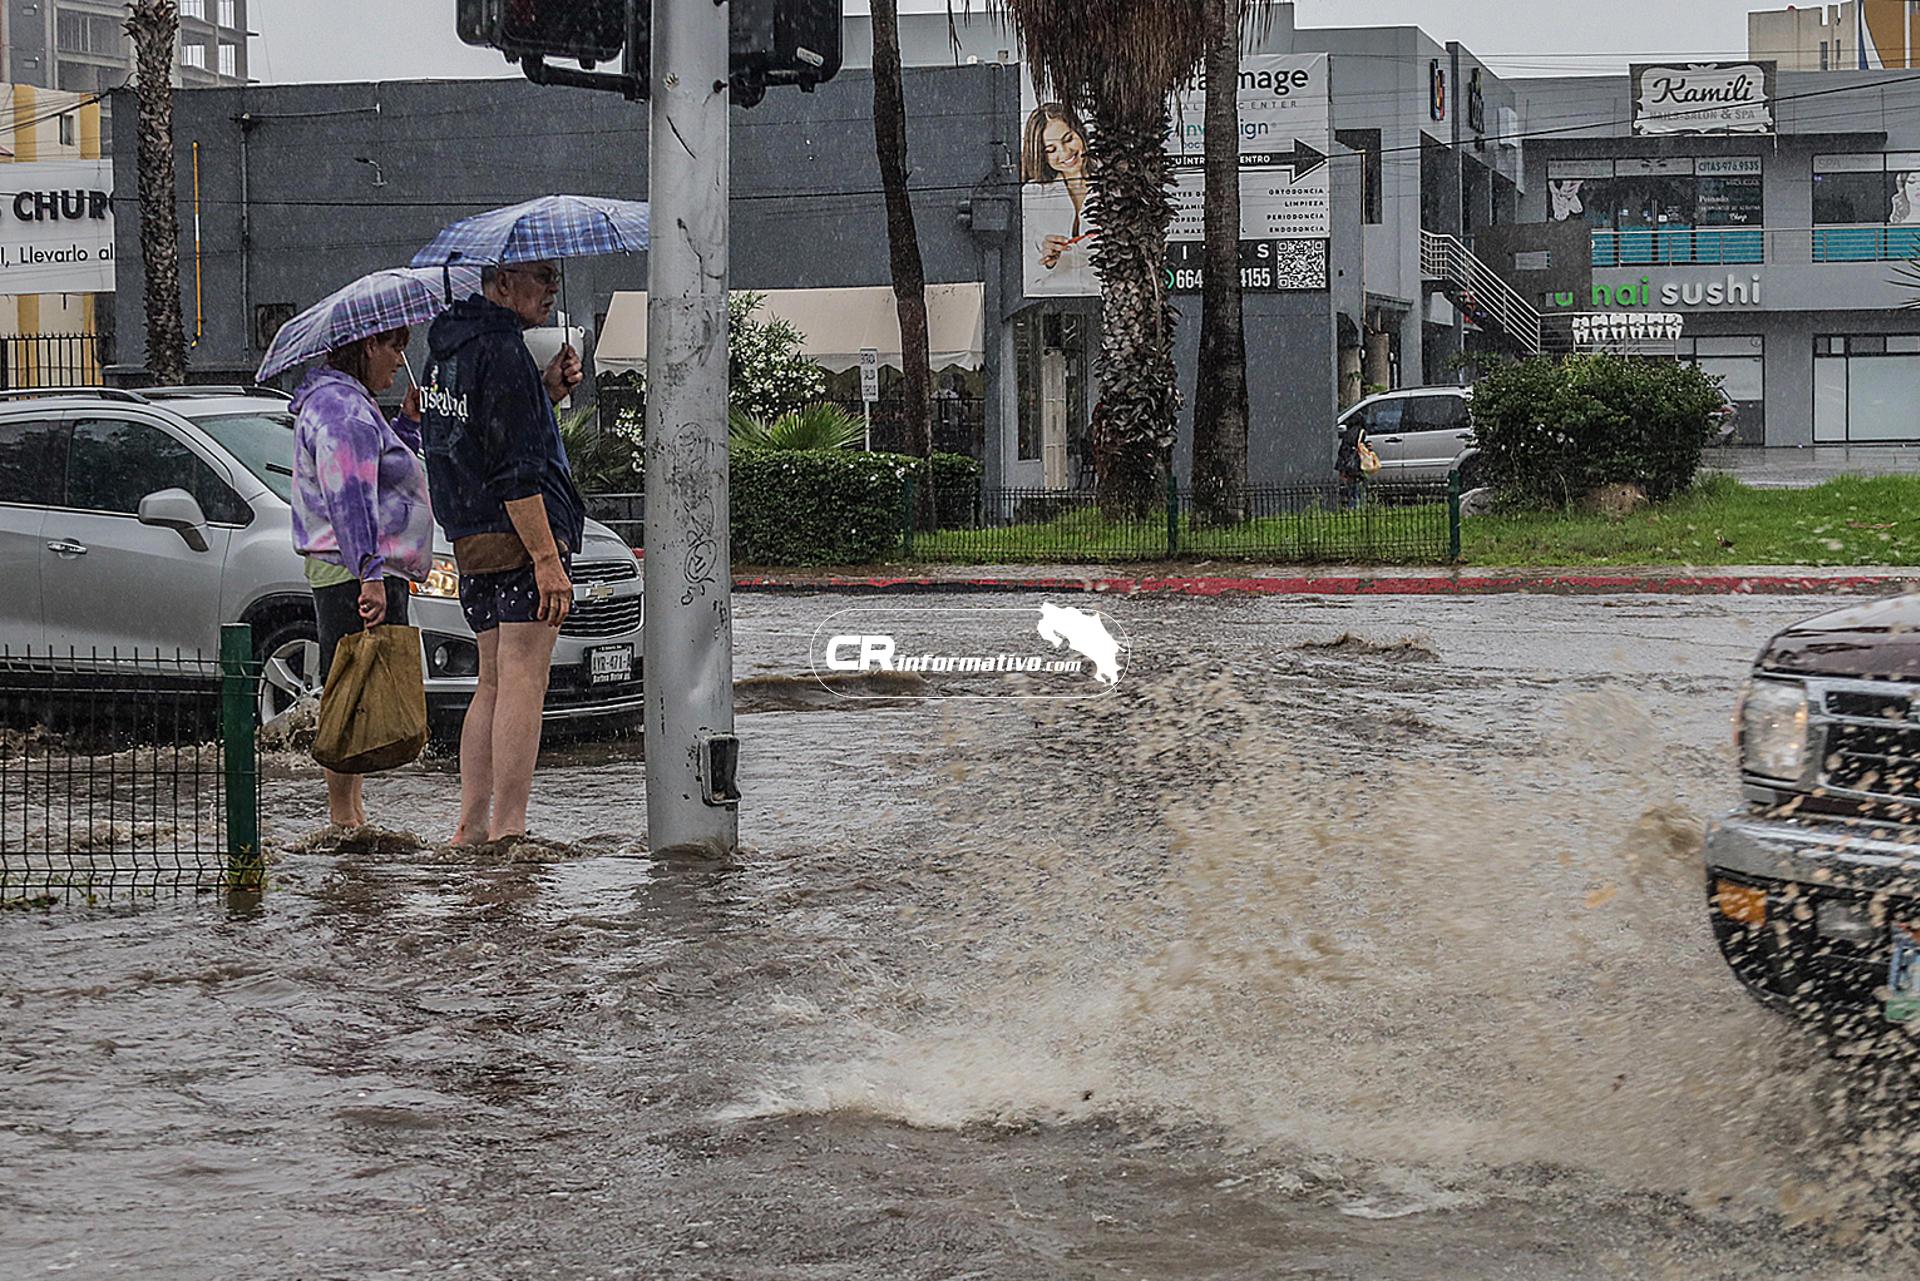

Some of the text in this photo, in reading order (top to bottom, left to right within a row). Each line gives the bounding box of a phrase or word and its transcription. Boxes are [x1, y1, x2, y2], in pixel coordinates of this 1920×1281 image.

[1651, 74, 1754, 103] Kamili
[1238, 101, 1298, 110] CENTER
[1735, 109, 1755, 119] SPA
[1239, 154, 1271, 164] ENTRO
[1268, 188, 1324, 196] ORTODONCIA
[1284, 200, 1324, 208] LIMPIEZA
[1266, 213, 1325, 221] PERIODONCIA
[20, 244, 89, 264] Llevarlo
[1660, 274, 1761, 306] sushi
